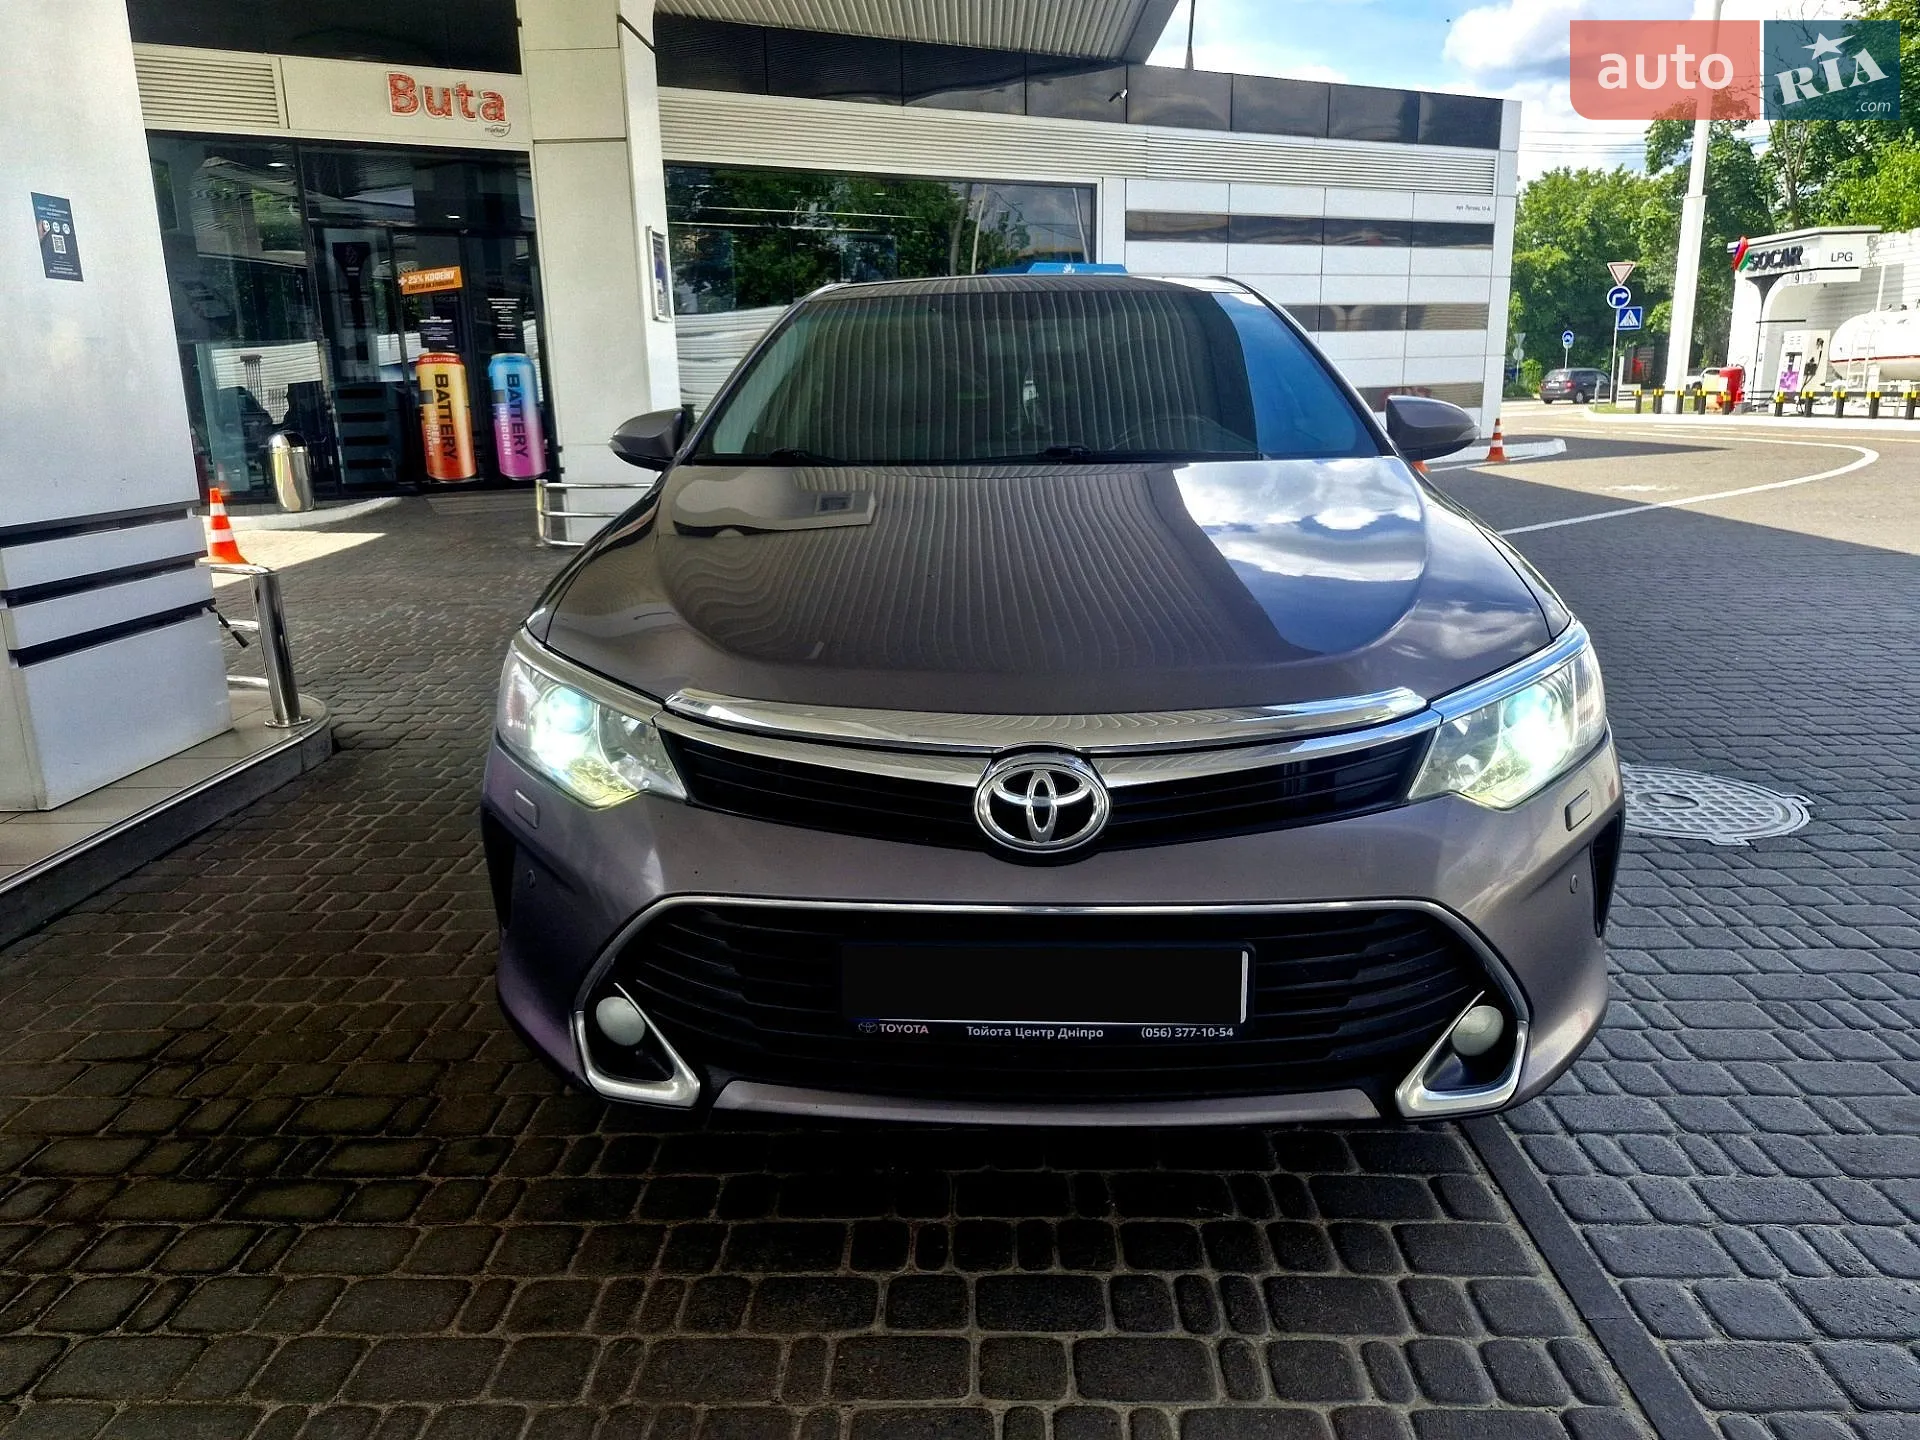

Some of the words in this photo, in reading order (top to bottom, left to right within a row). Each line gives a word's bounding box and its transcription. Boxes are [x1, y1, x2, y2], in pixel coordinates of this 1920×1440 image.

[387, 71, 507, 122] Buta
[1748, 245, 1803, 271] SOCAR
[1830, 251, 1853, 263] LPG
[434, 373, 458, 460] BATTERY
[507, 373, 529, 459] BATTERY
[500, 406, 512, 456] UNICORN
[879, 1023, 929, 1035] TOYOTA
[966, 1025, 1012, 1038] Тойота
[1015, 1026, 1056, 1040] Центр
[1058, 1026, 1104, 1040] Дніпро
[1141, 1026, 1172, 1040] (056)
[1175, 1026, 1234, 1038] 377-10-54
